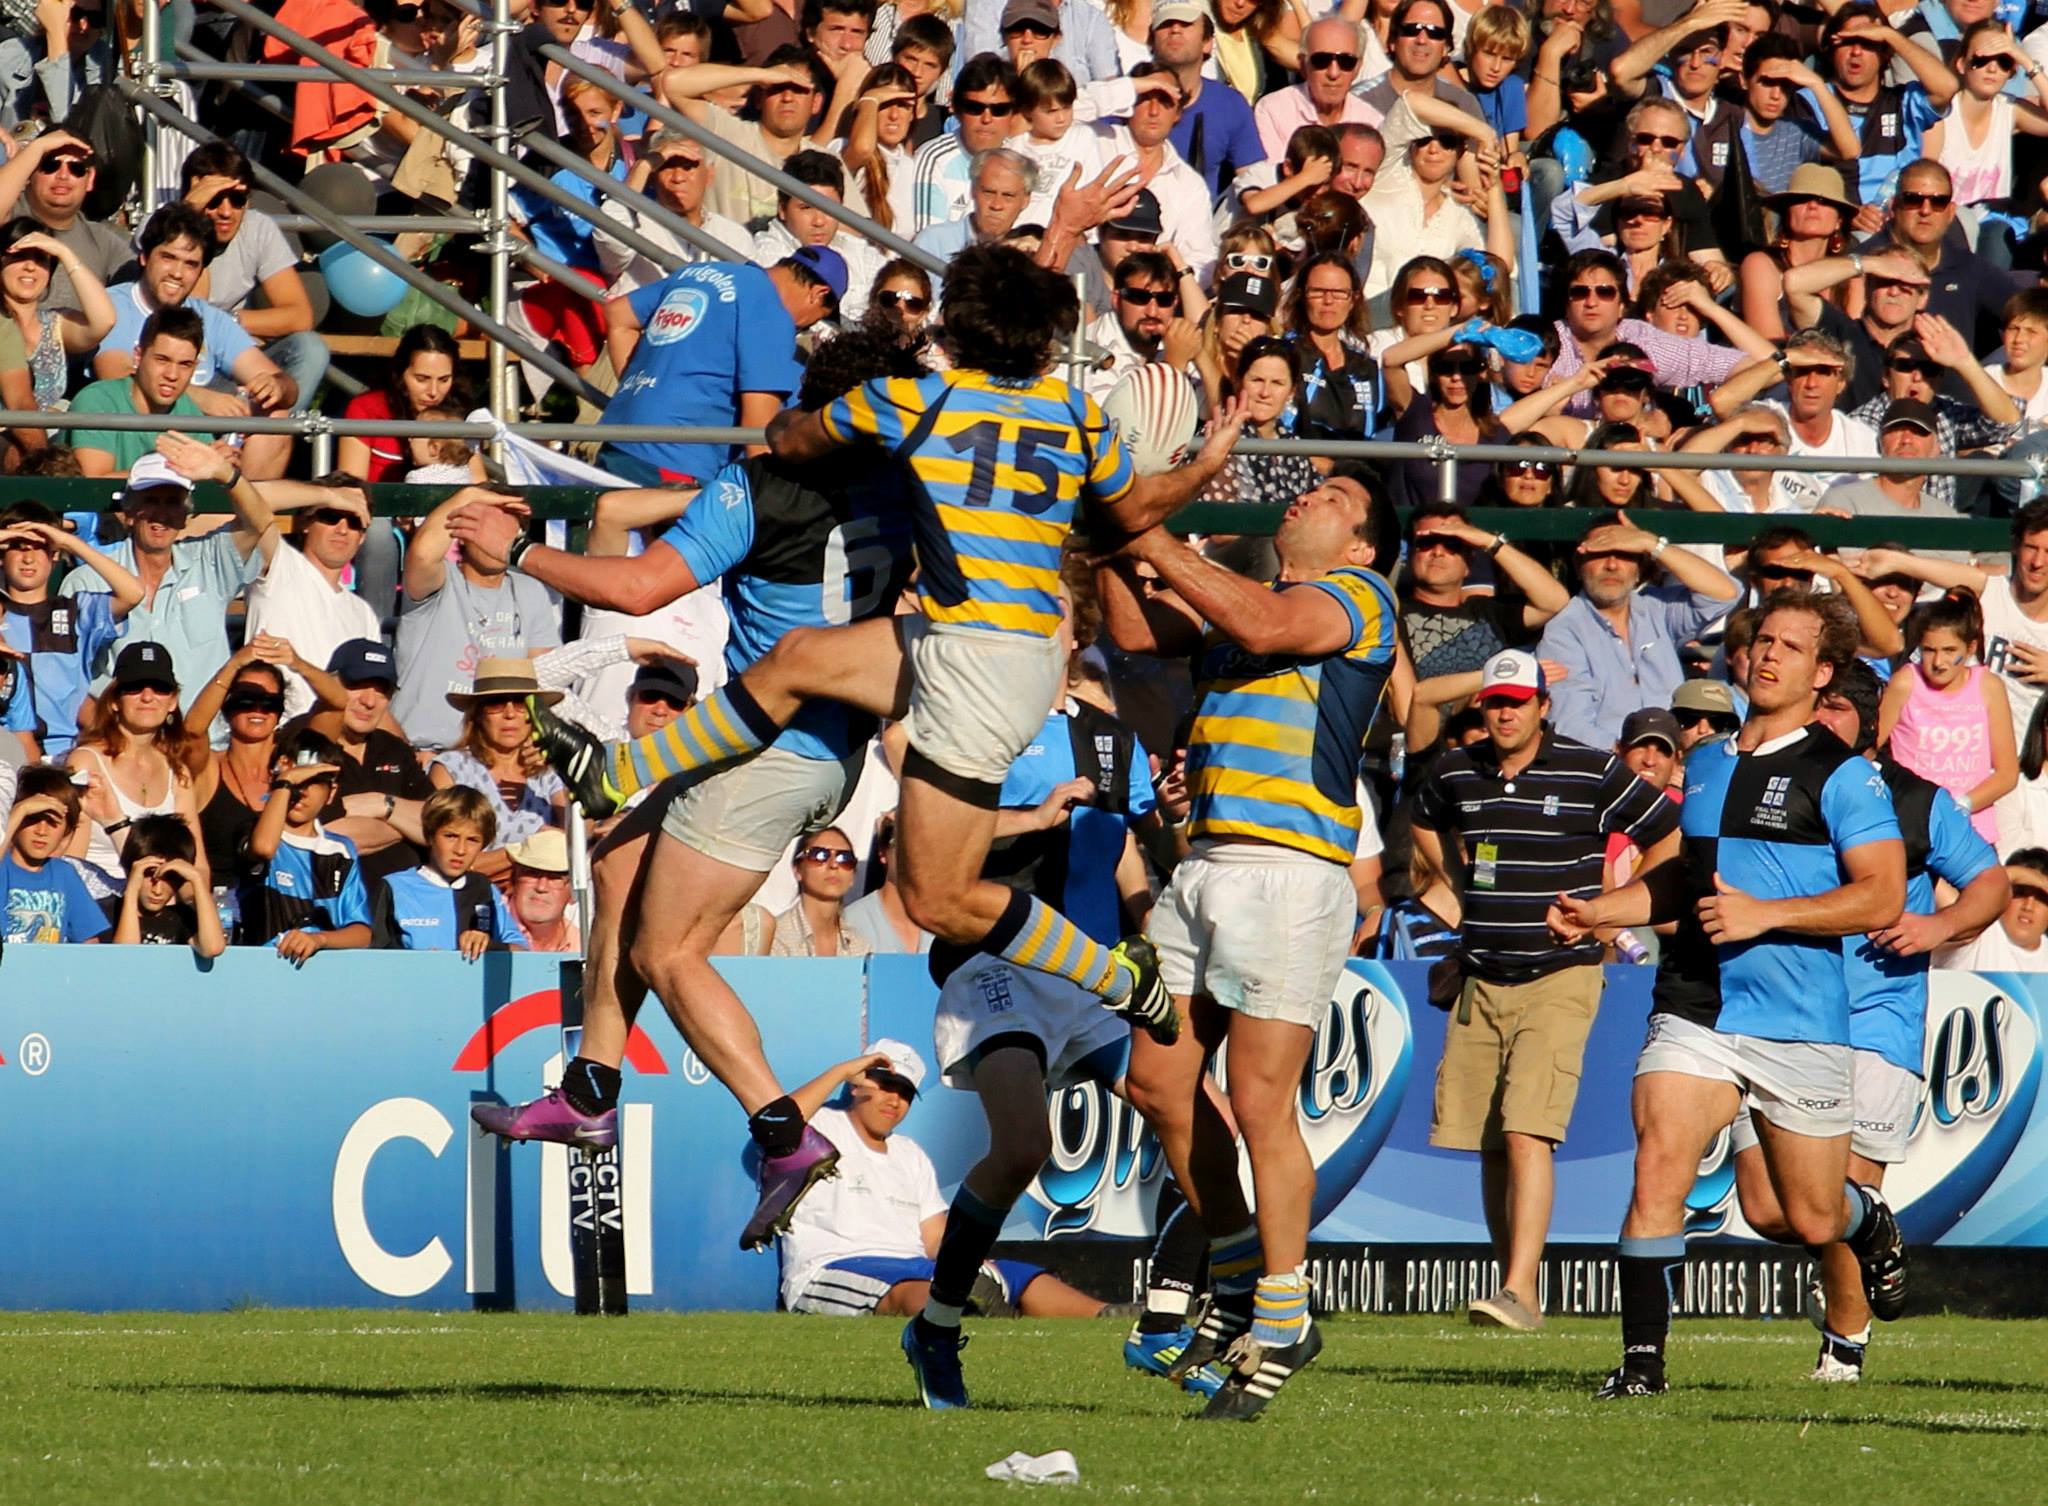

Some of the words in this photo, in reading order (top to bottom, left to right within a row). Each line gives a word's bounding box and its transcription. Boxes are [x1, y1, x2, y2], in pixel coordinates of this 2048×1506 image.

[945, 420, 1070, 515] 15
[822, 514, 894, 627] 6
[1852, 1119, 1895, 1132] PROCER
[333, 1052, 653, 1298] citi
[568, 1146, 595, 1231] ECTV
[595, 1144, 622, 1231] ECTV
[1310, 1247, 1393, 1312] RACIÓN.
[1405, 1260, 1500, 1312] PROHIBID
[1538, 1260, 1549, 1312] U
[1561, 1260, 1622, 1312] VENTA
[1672, 1261, 1746, 1314] NORES
[1760, 1262, 1781, 1314] DE
[1627, 1344, 1657, 1354] CER
